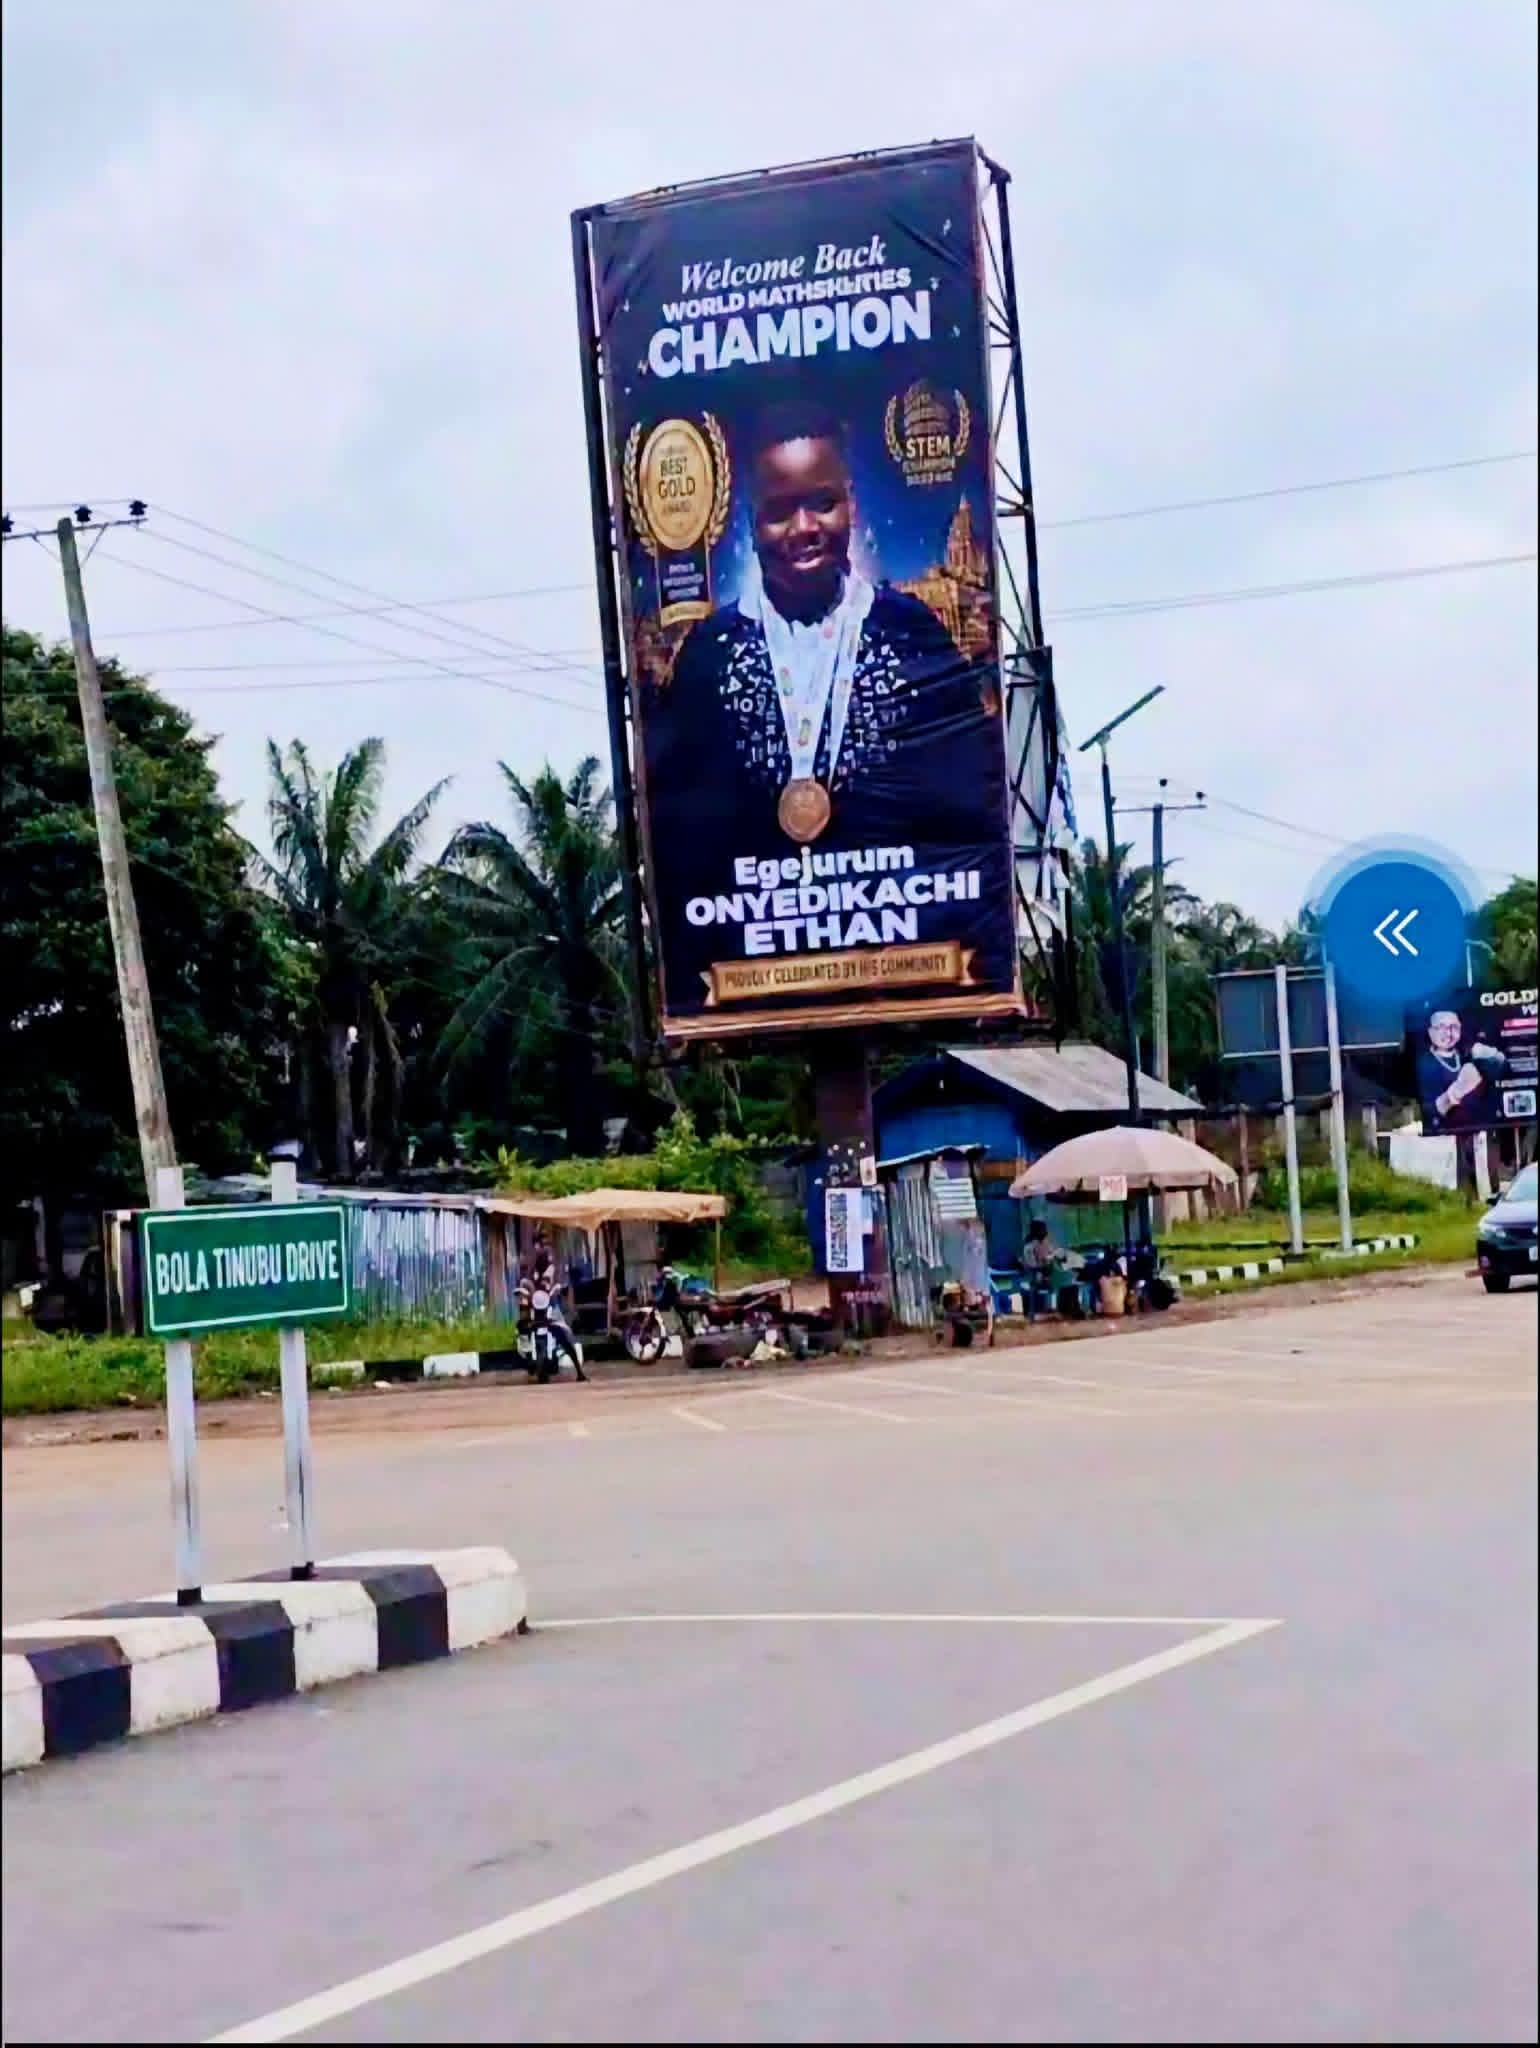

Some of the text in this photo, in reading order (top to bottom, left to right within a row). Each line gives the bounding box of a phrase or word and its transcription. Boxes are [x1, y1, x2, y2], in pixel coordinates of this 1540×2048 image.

[681, 234, 887, 294] Welcome Back
[662, 292, 747, 323] WORLD
[648, 290, 932, 378] CHAMPION
[906, 435, 951, 458] STEM
[658, 475, 696, 499] GOLD
[734, 845, 914, 888] Egejurum
[686, 870, 981, 926] ONYEDIKACHI
[744, 907, 918, 955] ETHAN
[155, 1239, 340, 1295] BOLA TINUBU DRIVE
